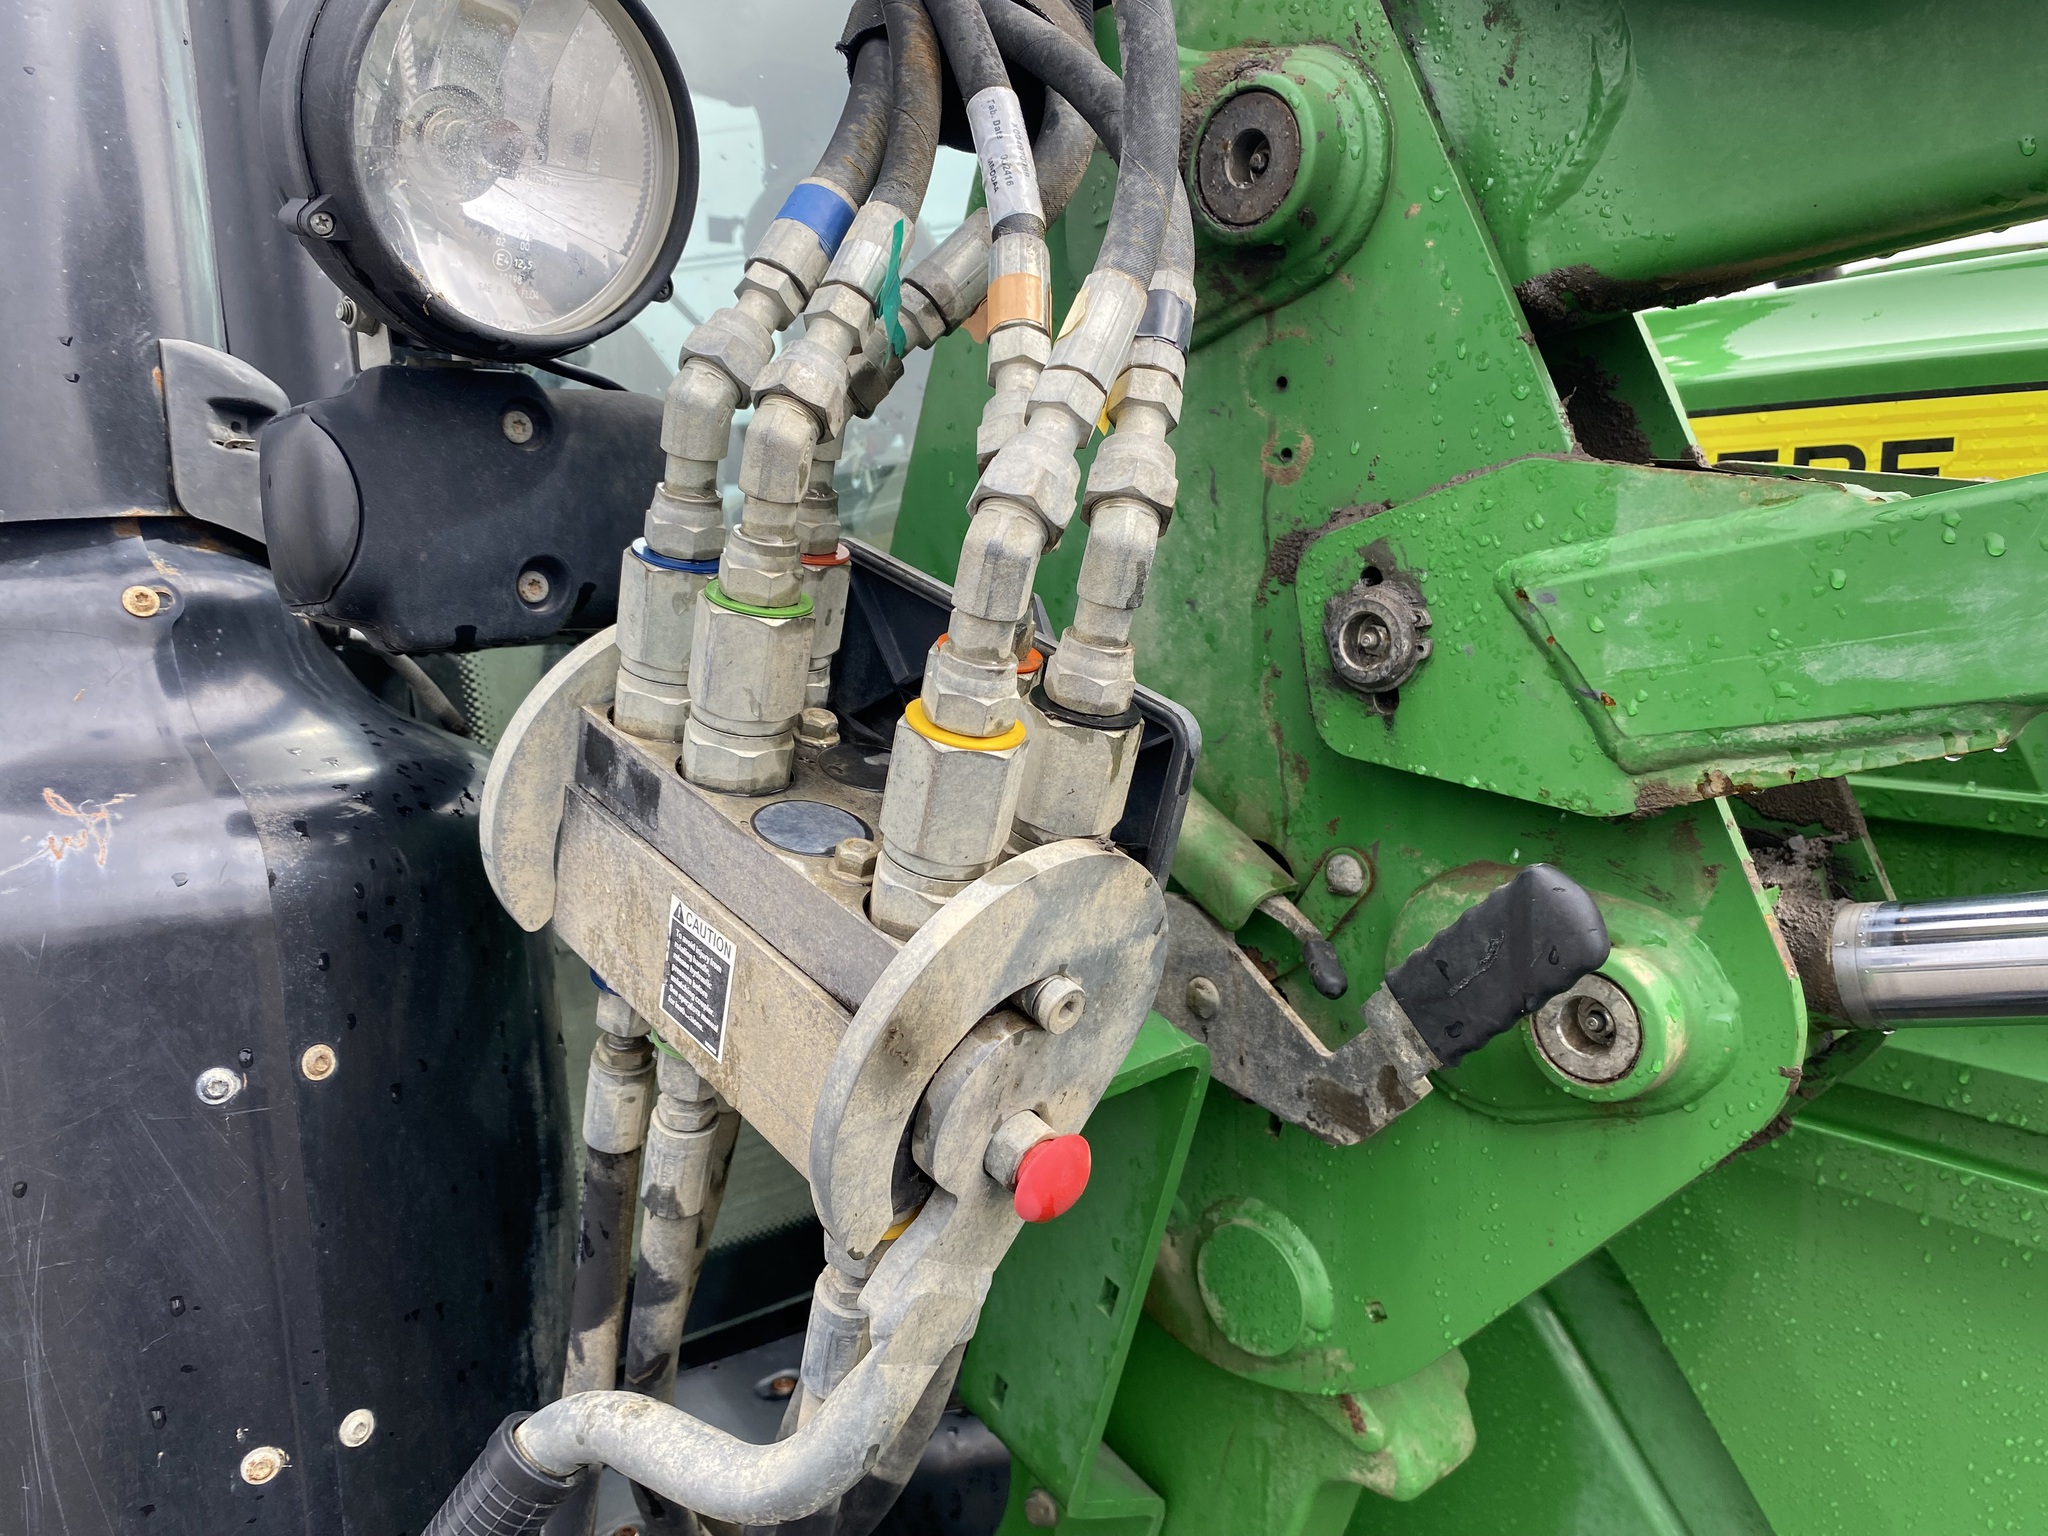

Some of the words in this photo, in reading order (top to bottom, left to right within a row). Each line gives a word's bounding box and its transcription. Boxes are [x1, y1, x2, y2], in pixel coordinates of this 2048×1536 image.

[993, 120, 1003, 140] Date
[495, 237, 507, 247] 02
[520, 241, 531, 252] 00
[496, 253, 510, 266] E4
[477, 281, 493, 293] SAE
[675, 927, 682, 940] To
[685, 912, 731, 959] CAUTION
